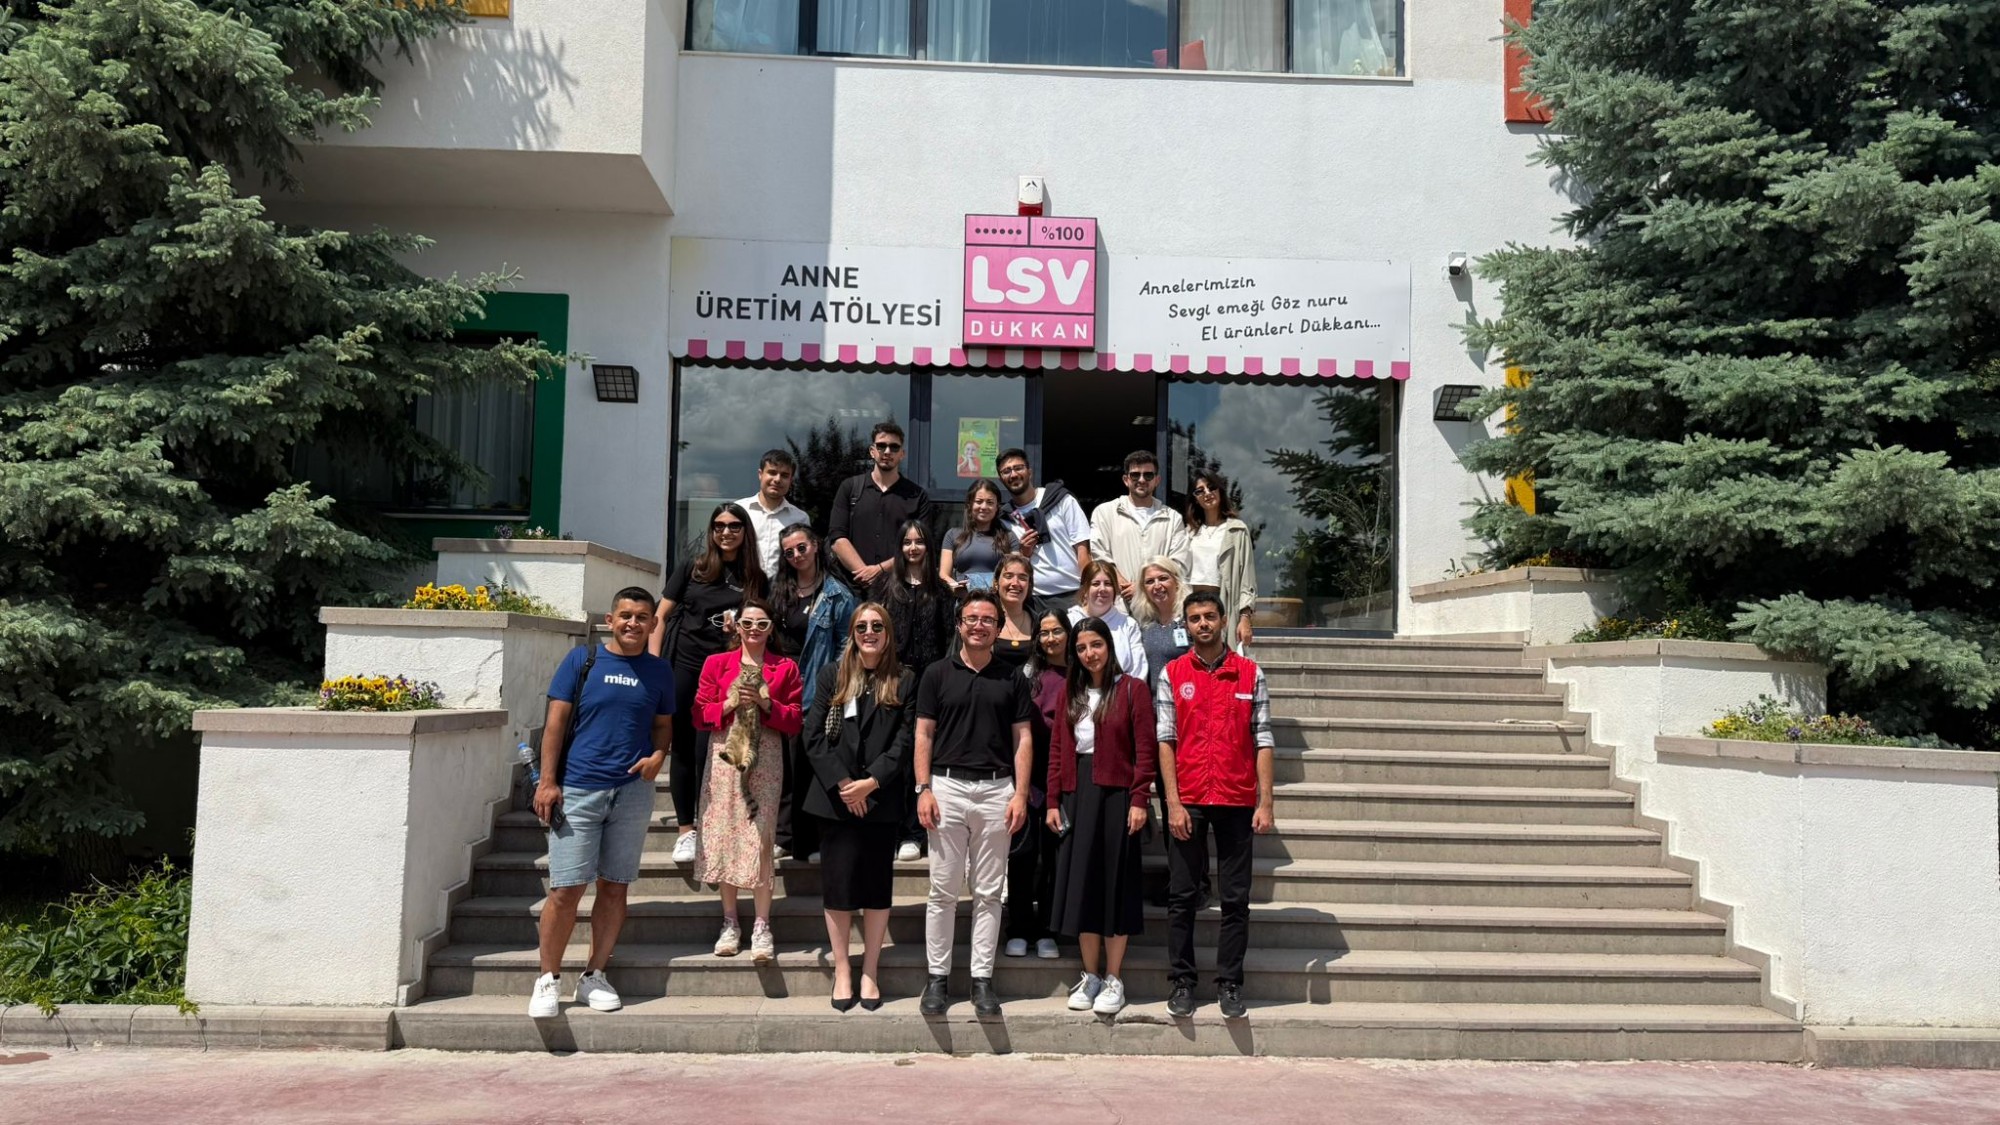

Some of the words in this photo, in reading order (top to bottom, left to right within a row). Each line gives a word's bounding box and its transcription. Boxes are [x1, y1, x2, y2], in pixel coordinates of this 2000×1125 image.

[1041, 226, 1084, 241] %100
[780, 264, 859, 289] ANNE
[971, 255, 1090, 306] LSV
[1139, 276, 1256, 296] Annelerimizin
[696, 291, 801, 321] ÜRETİM
[810, 296, 941, 326] ATÖLYESİ
[1168, 303, 1211, 321] Sevgi
[1217, 299, 1265, 317] emeği
[1271, 295, 1301, 310] Göz
[1307, 295, 1349, 308] nuru
[970, 320, 1088, 339] DÜKKAN
[1201, 325, 1218, 341] El
[1224, 321, 1294, 339] ürünleri
[604, 674, 639, 687] miav
